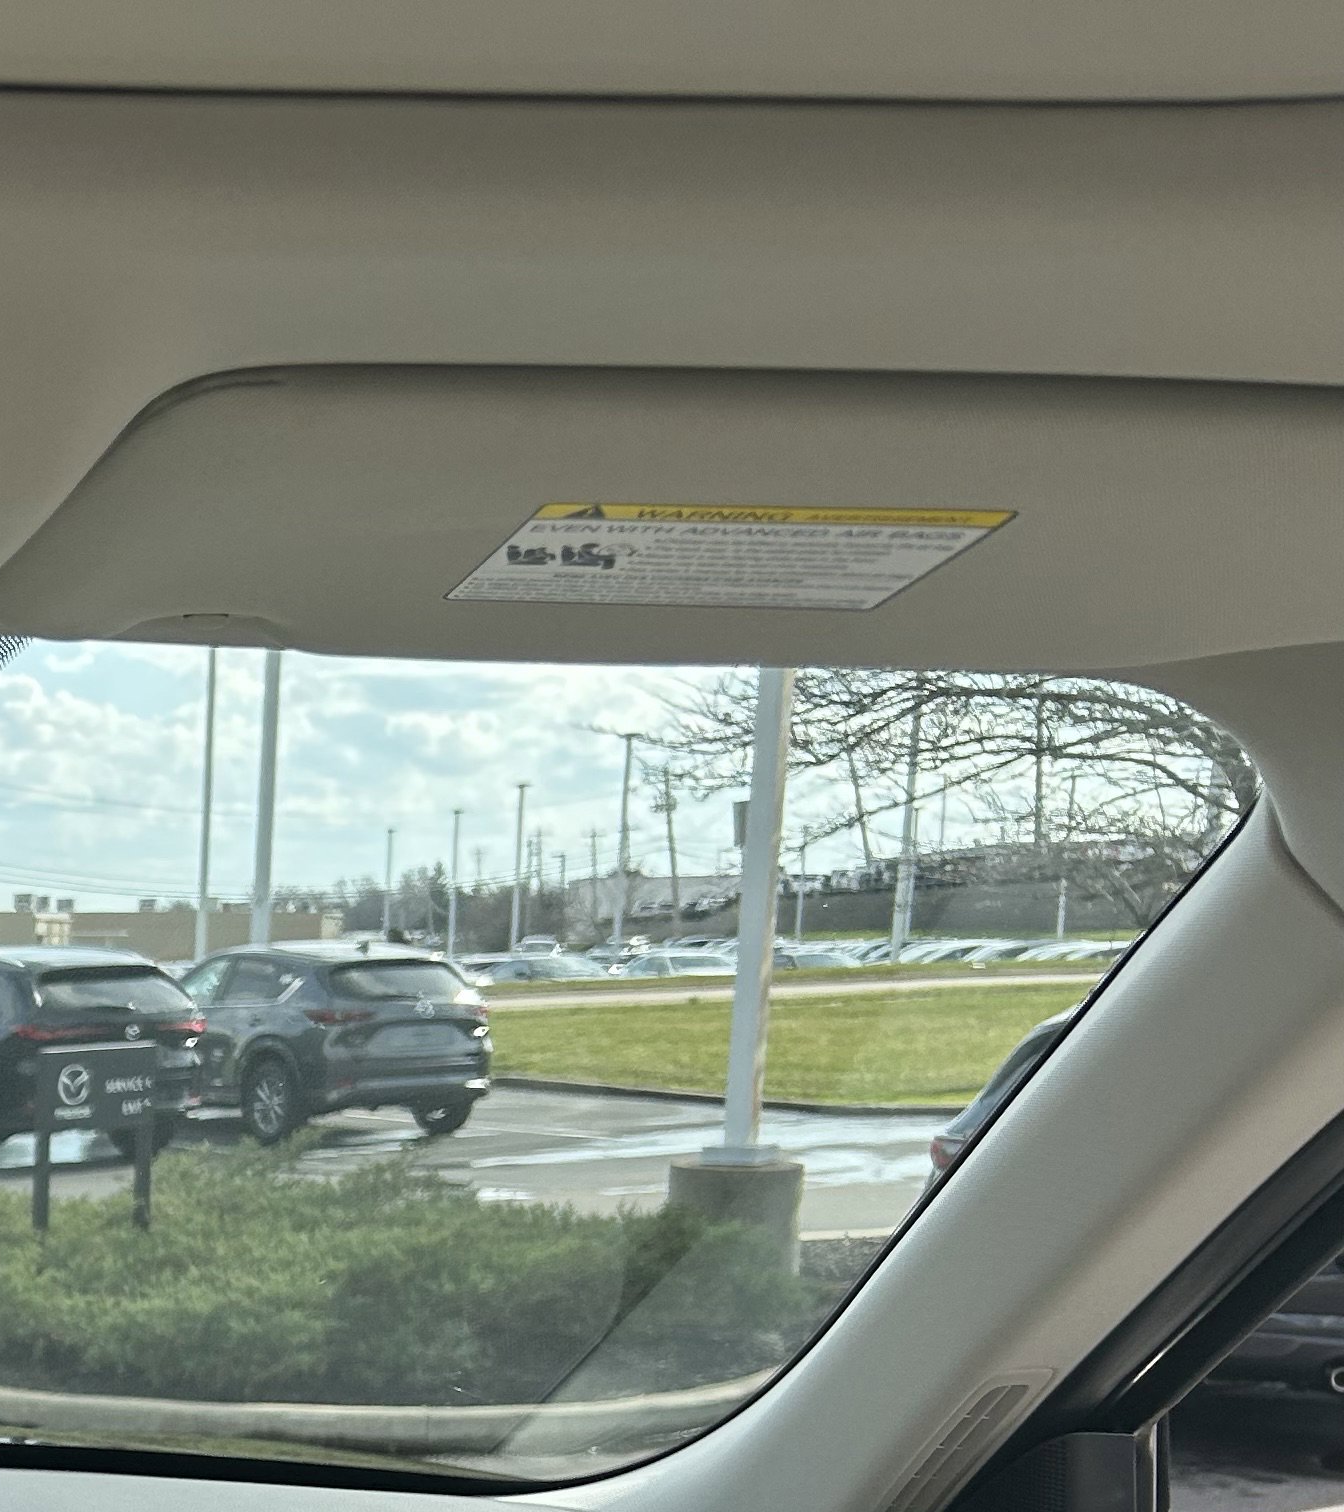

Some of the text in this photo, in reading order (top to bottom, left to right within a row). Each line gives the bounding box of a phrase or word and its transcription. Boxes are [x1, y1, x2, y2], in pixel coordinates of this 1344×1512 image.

[637, 508, 794, 522] WARNING
[529, 523, 965, 540] EVEN WITH ADVANCED AIR BAGS
